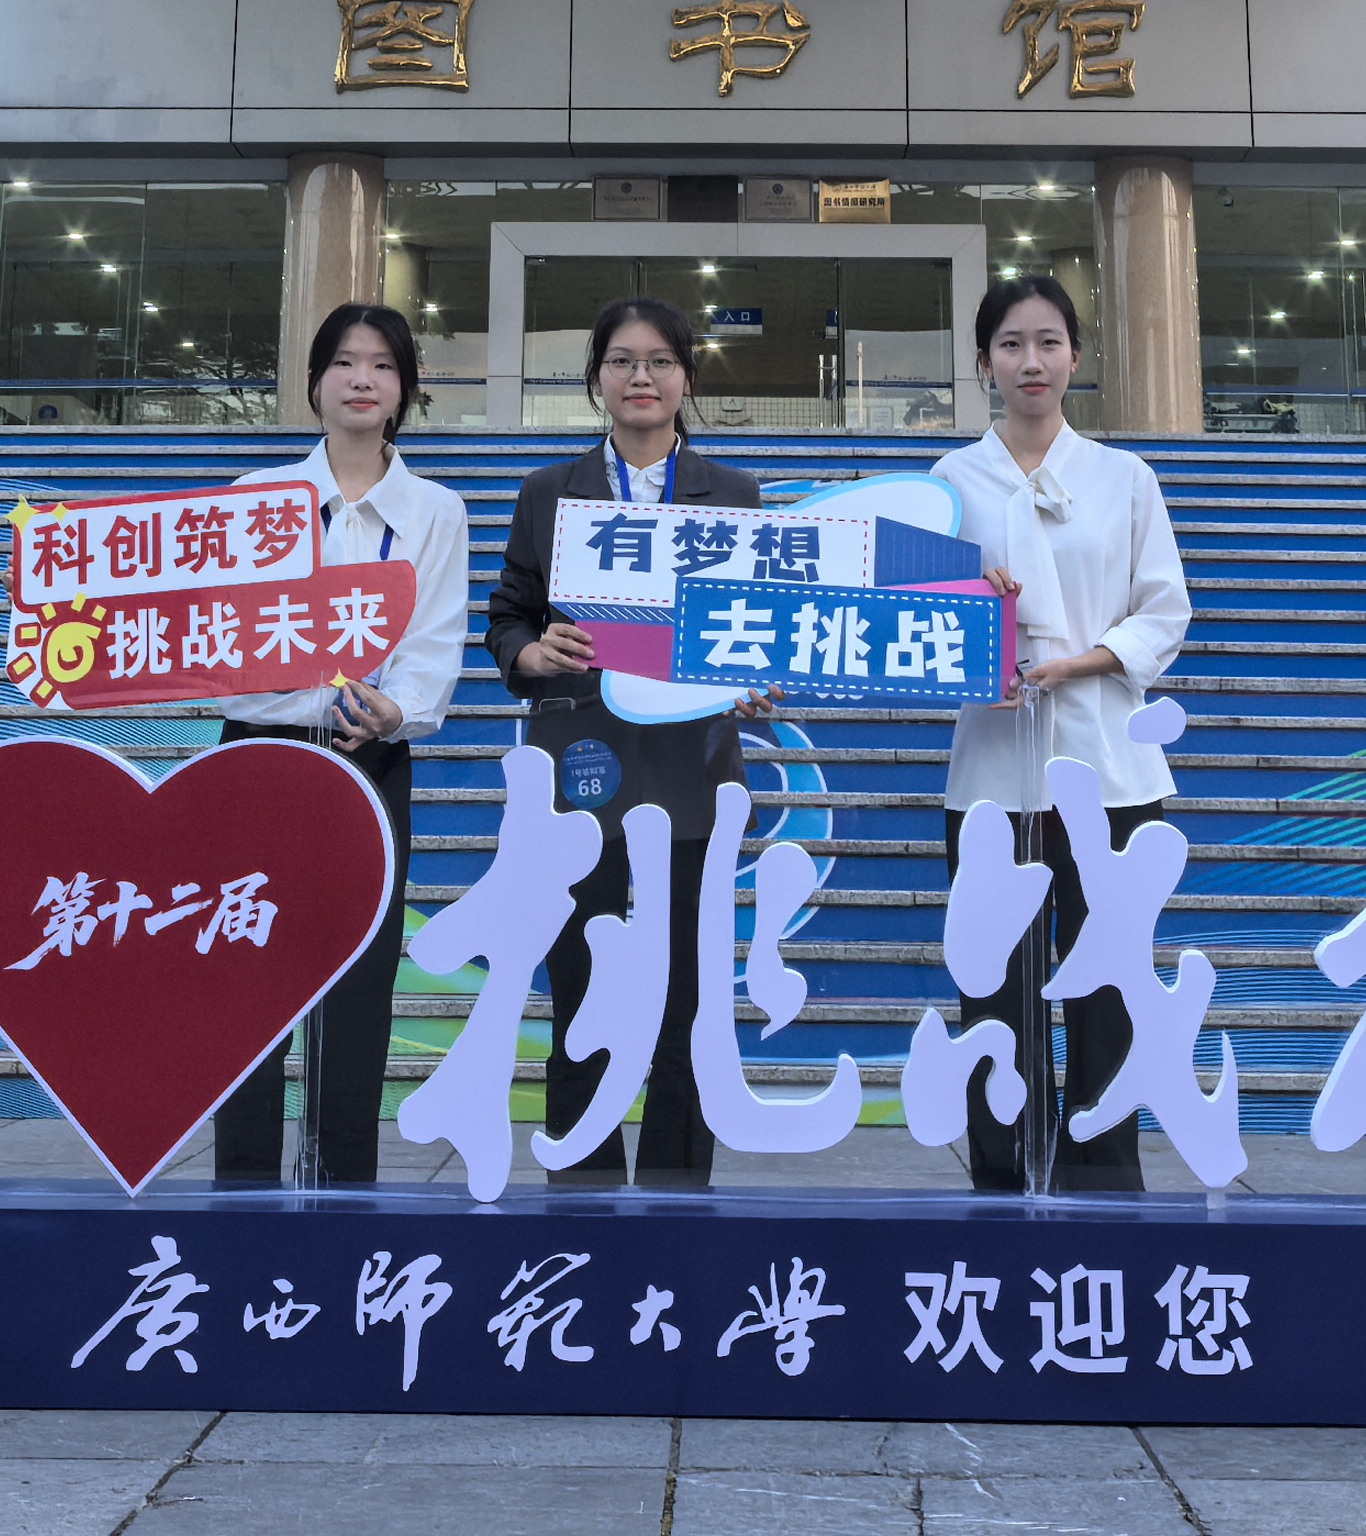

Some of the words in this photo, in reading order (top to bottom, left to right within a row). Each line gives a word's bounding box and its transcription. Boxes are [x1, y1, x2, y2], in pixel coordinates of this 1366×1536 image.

[724, 310, 751, 322] 入口
[31, 498, 307, 588] 科创筑梦
[586, 512, 821, 584] 有梦想
[105, 586, 391, 680] 挑战未来
[699, 597, 967, 684] 去挑战
[3, 871, 280, 970] 第十二届
[903, 1260, 1255, 1375] 欢迎您
